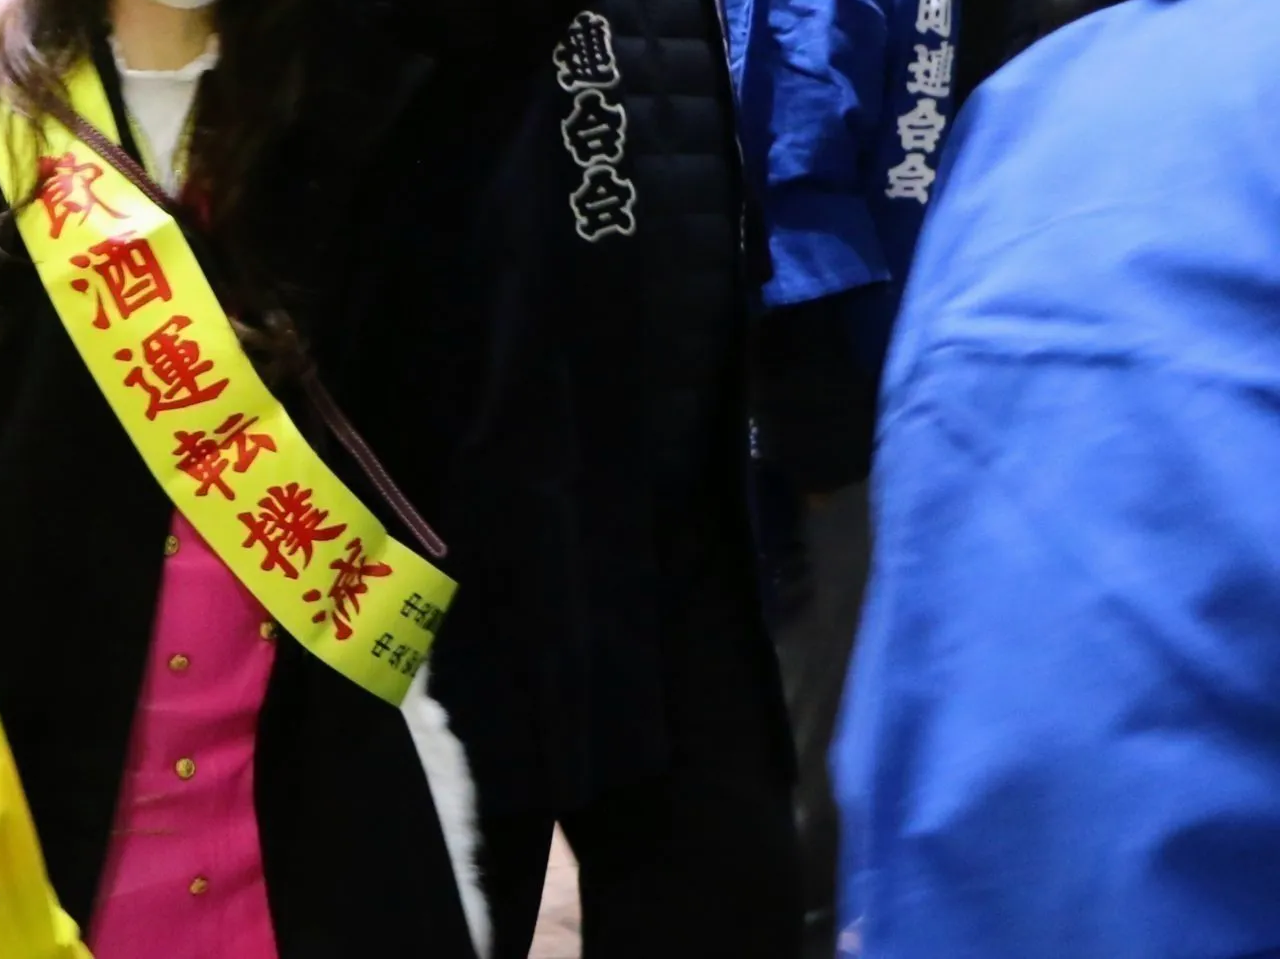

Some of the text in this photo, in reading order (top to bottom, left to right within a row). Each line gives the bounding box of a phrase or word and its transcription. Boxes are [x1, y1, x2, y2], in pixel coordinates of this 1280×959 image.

[34, 150, 394, 641] 飲酒運転撲滅
